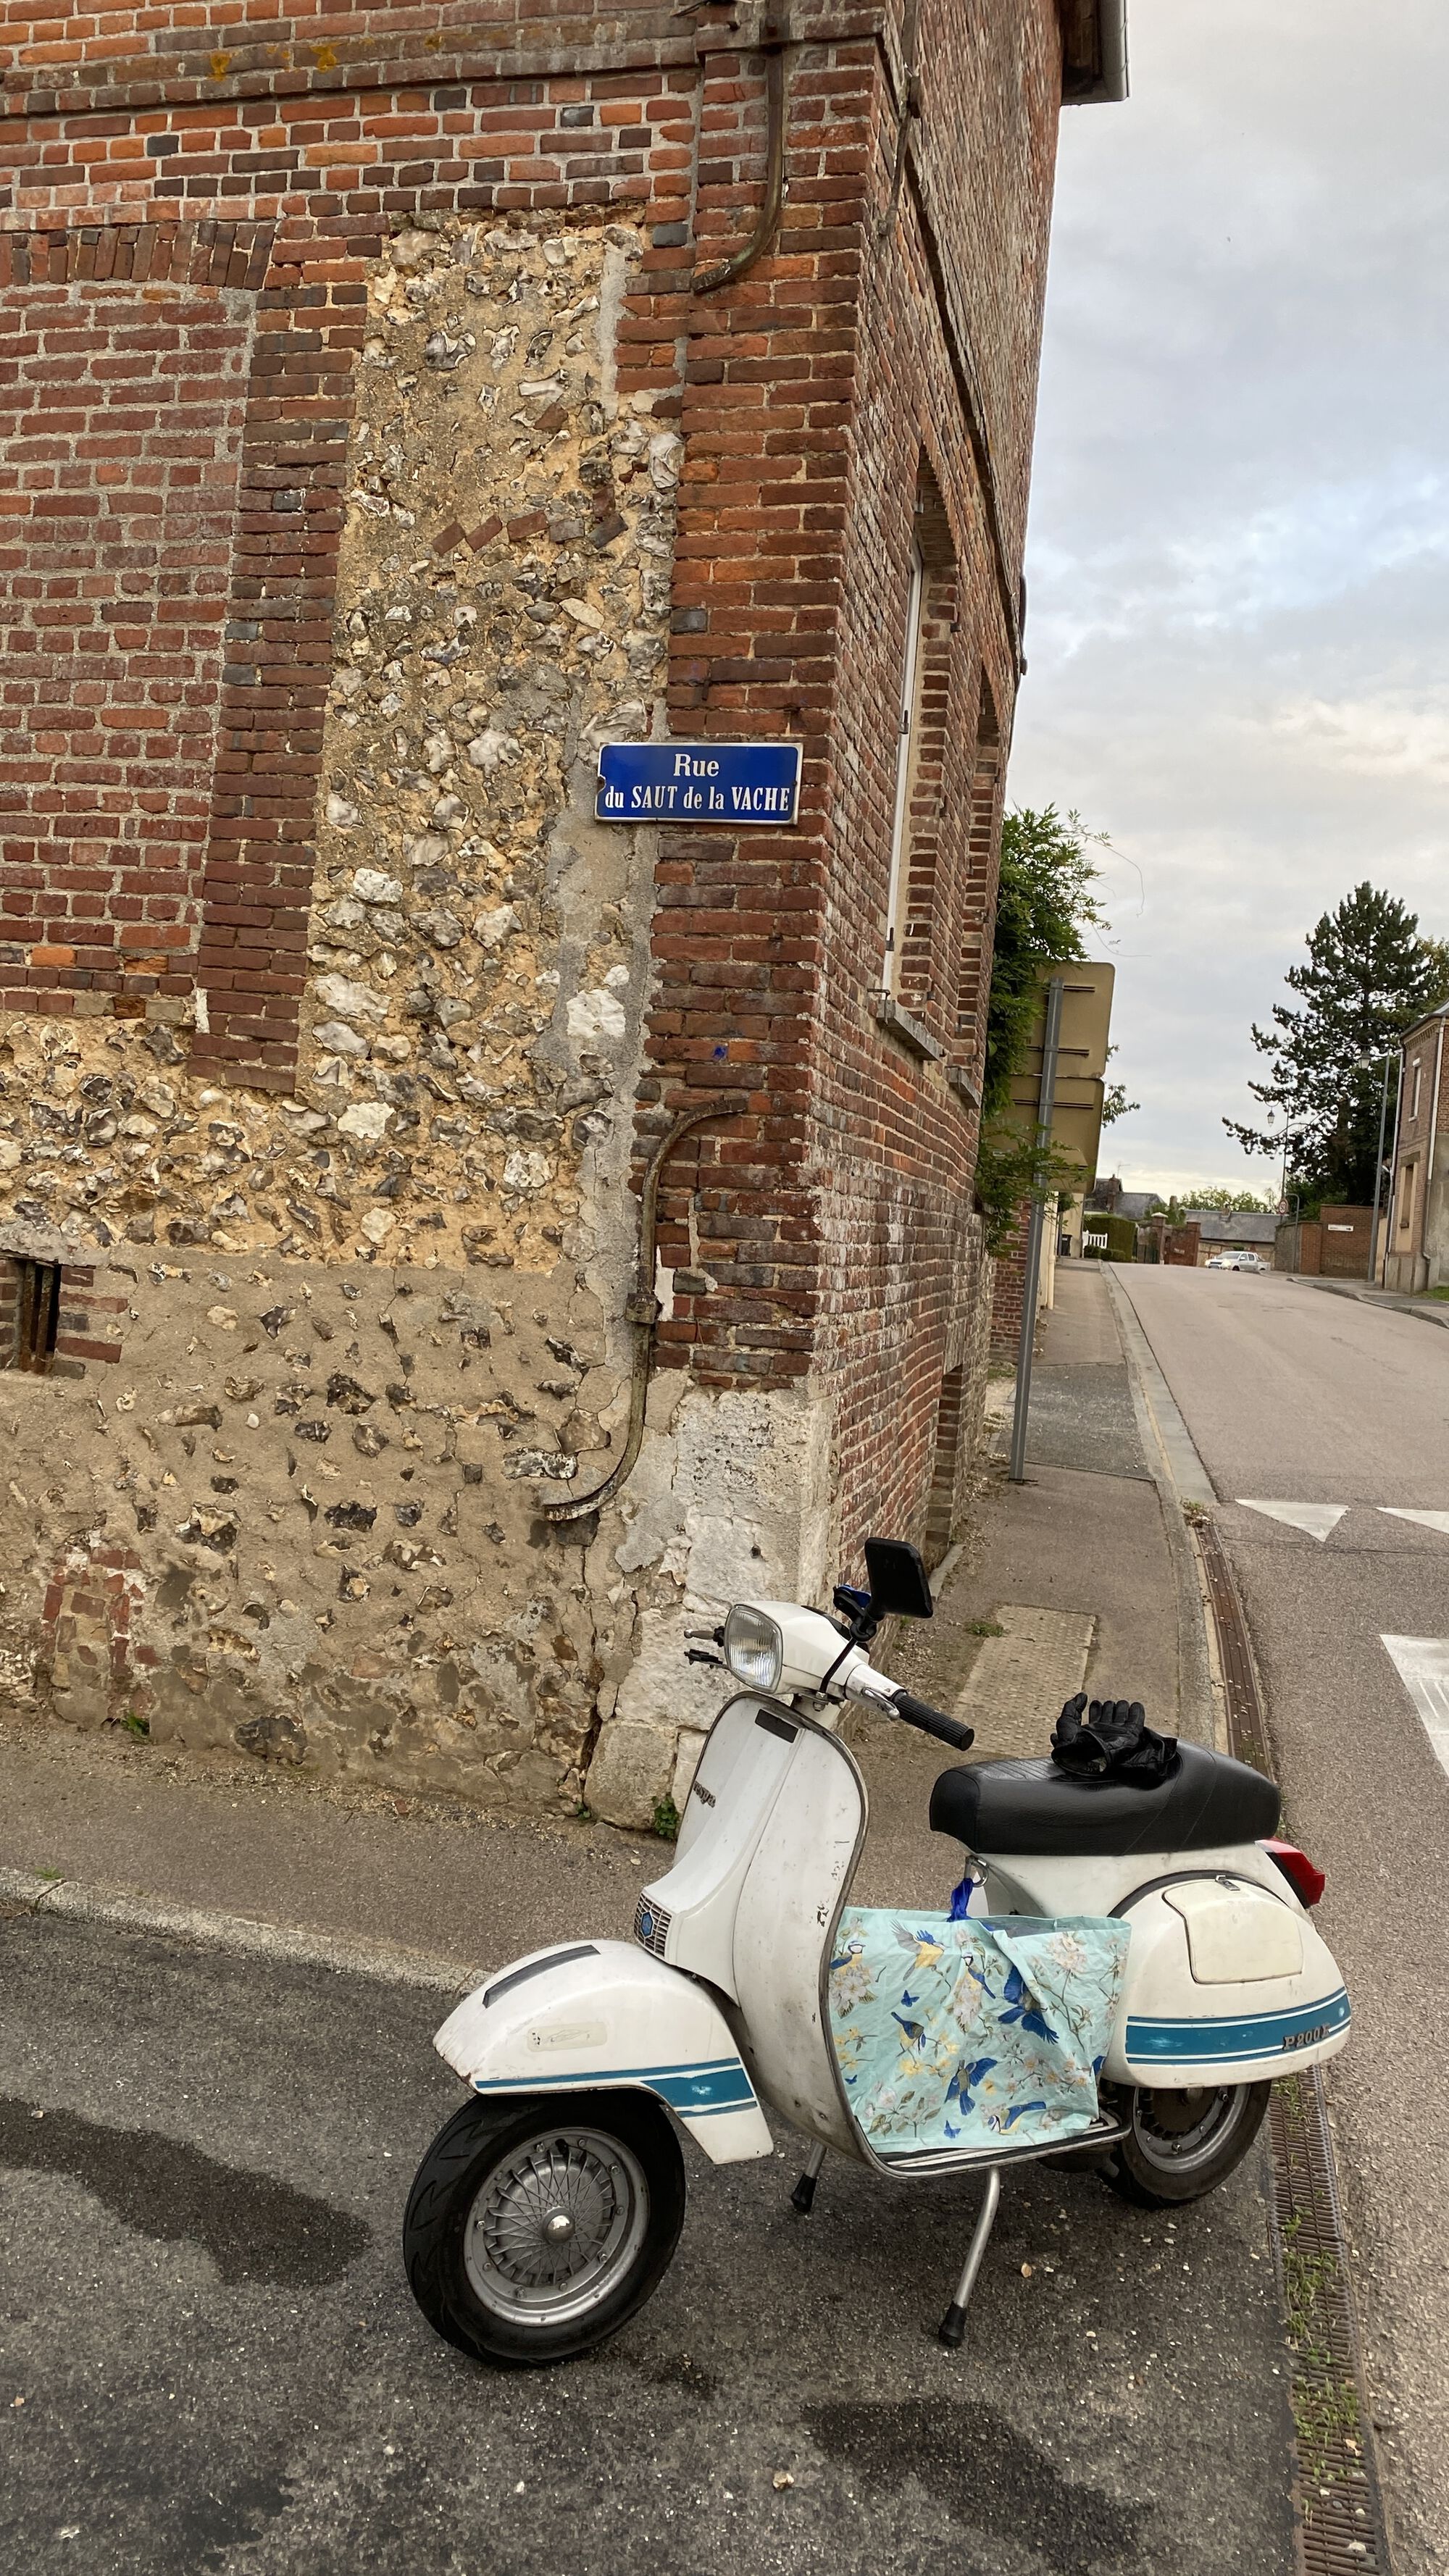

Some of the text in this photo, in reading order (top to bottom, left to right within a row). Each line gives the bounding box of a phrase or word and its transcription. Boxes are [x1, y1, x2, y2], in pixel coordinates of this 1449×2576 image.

[673, 753, 719, 777] Rue
[605, 785, 790, 811] du SAUT de la VACHE
